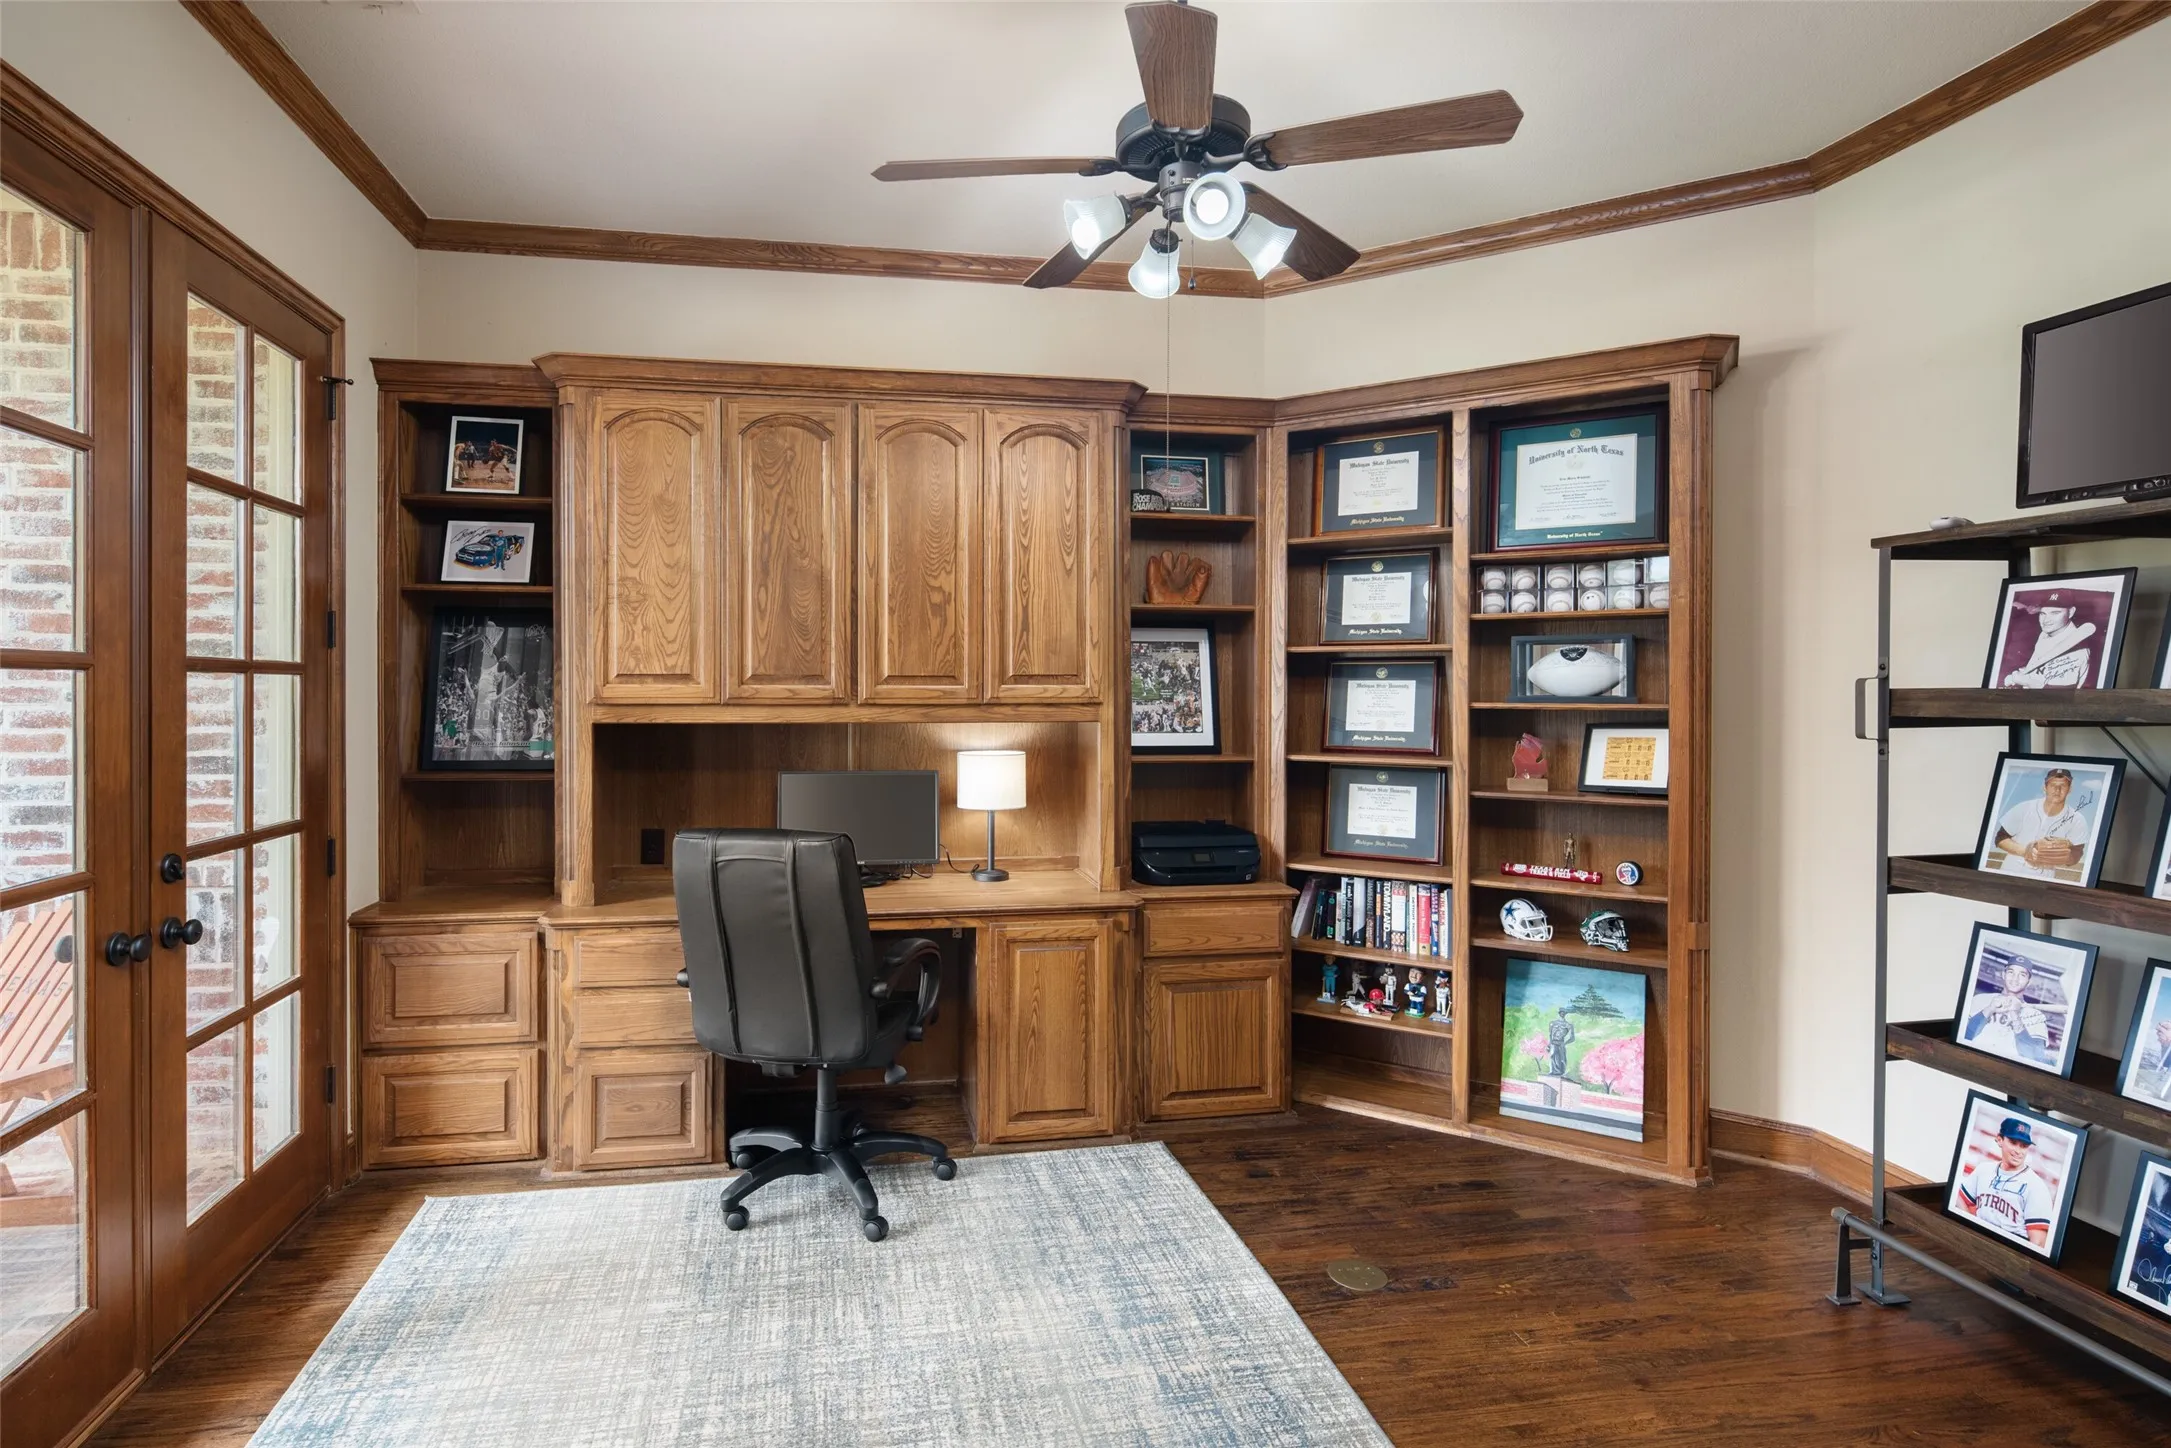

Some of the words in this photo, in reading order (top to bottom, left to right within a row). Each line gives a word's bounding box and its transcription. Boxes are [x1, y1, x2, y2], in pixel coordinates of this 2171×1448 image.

[1528, 449, 1565, 466] University
[1576, 445, 1598, 454] North
[1600, 444, 1624, 456] Texas
[1976, 1194, 2019, 1223] DETROIT
